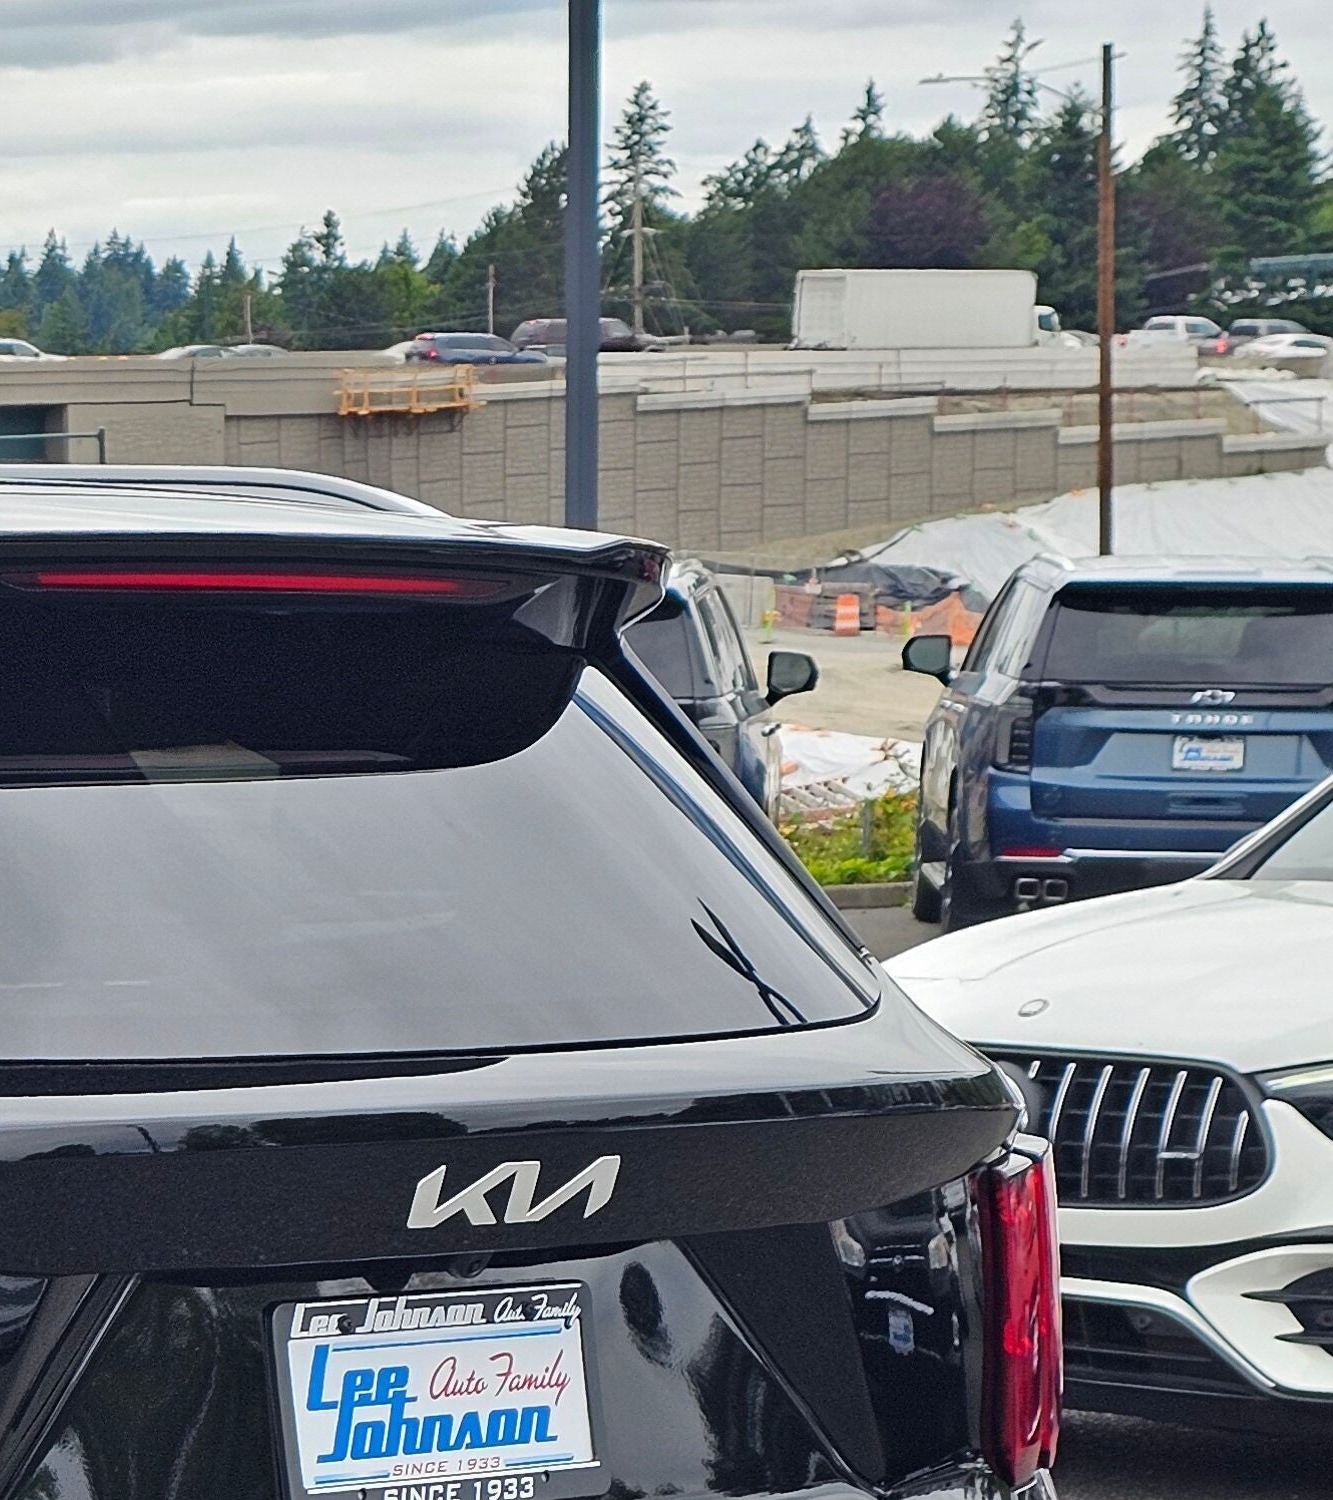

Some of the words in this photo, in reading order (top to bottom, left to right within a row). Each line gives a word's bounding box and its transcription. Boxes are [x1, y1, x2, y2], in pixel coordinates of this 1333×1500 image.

[355, 1297, 487, 1333] Johnson
[493, 1296, 528, 1323] Aut
[533, 1292, 581, 1330] Family
[307, 1344, 418, 1411] Lee
[430, 1356, 487, 1400] Auto
[489, 1348, 571, 1405] Family
[316, 1394, 558, 1464] Johnson
[392, 1460, 447, 1477] SINCE
[457, 1456, 502, 1471] 1933
